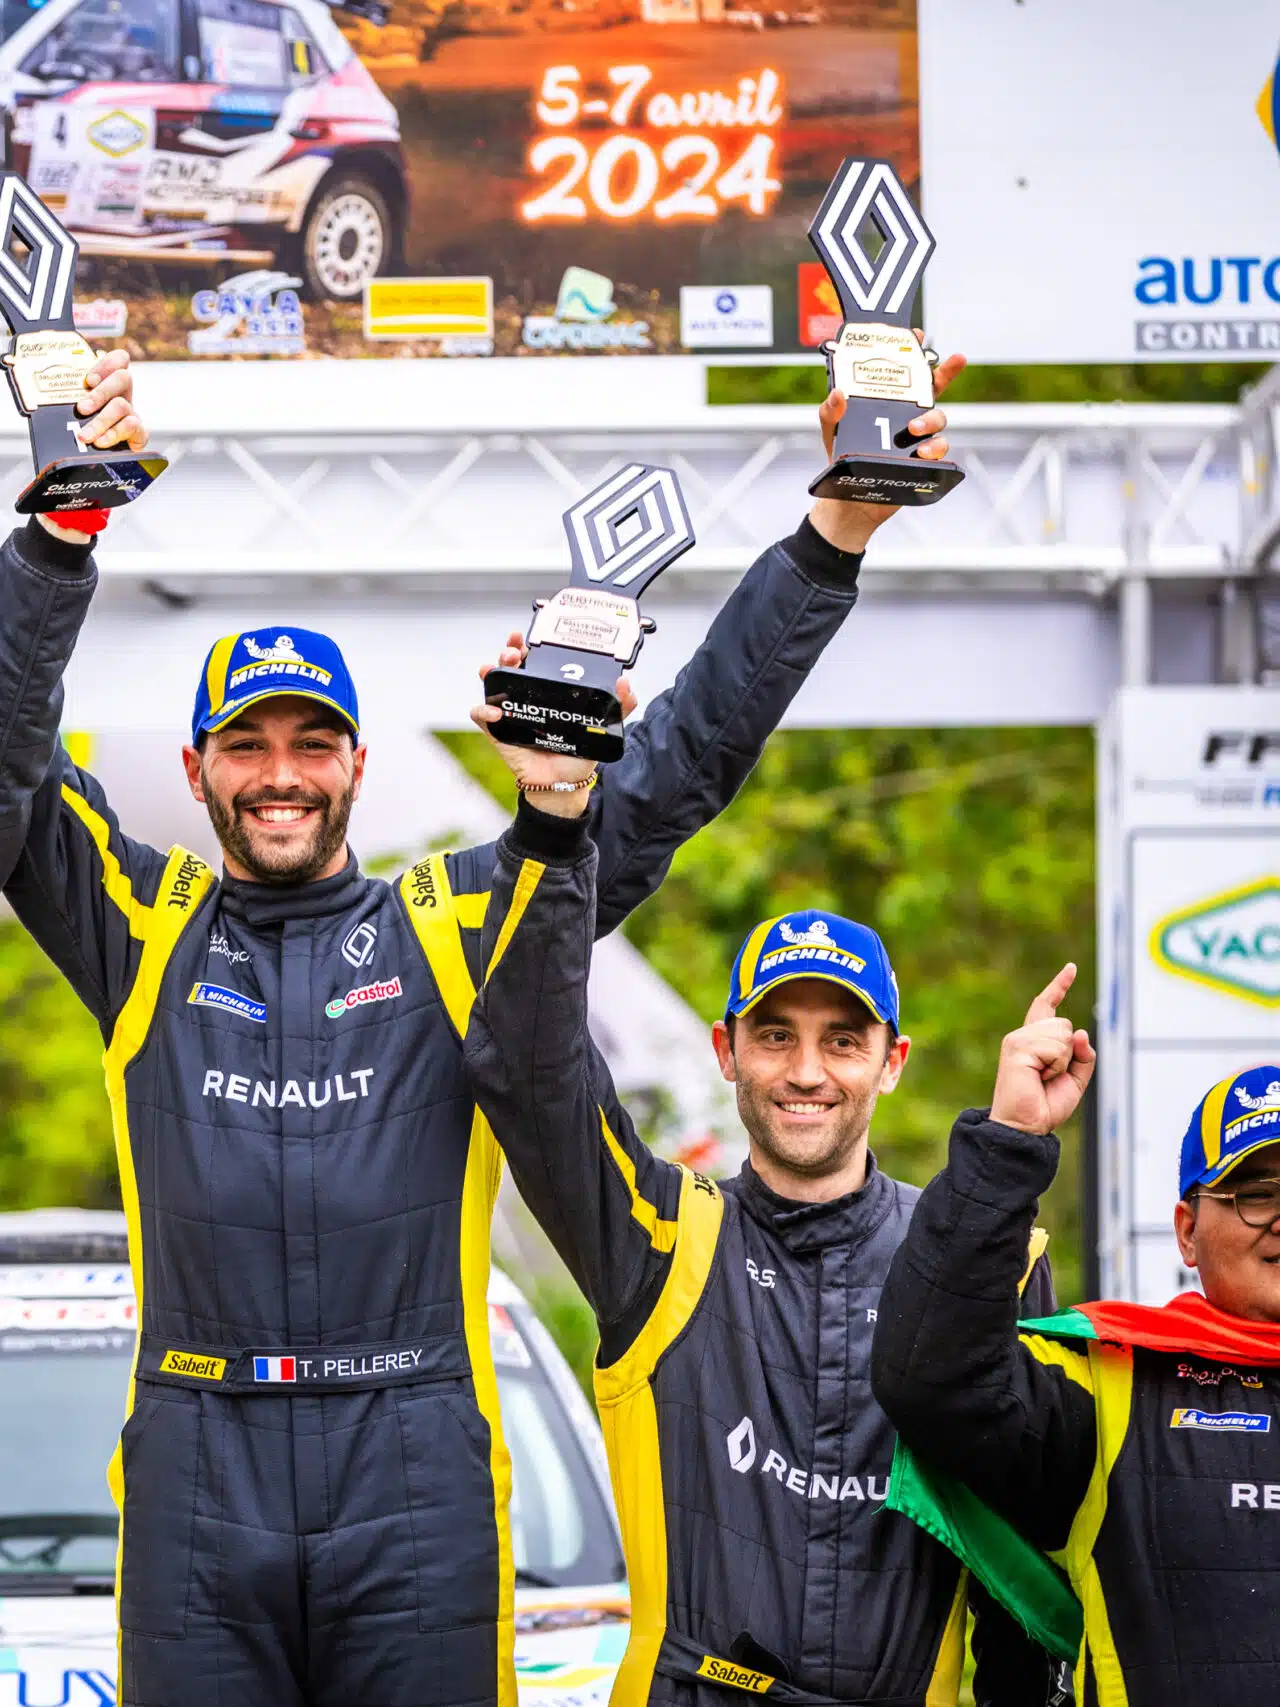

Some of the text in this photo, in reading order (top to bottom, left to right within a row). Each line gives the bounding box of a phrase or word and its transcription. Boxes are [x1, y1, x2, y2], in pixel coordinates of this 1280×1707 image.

[538, 65, 782, 127] 5-7 avril
[523, 135, 782, 221] 2024
[66, 421, 88, 453] 1
[874, 416, 892, 451] 1
[47, 477, 142, 493] CLIOTROPHY
[838, 475, 940, 490] CLIOTROPHY
[229, 663, 333, 690] MICHELIN
[501, 700, 606, 727] CLIOTROPHY
[512, 711, 546, 724] FRANCE
[167, 854, 207, 911] Sabelt
[759, 948, 866, 975] MICHELIN
[206, 991, 265, 1017] MICHELIN
[346, 979, 400, 1007] Castrol
[202, 1067, 375, 1109] RENAULT
[167, 1353, 220, 1377] Sabelt
[299, 1349, 423, 1379] T. PELLEREY
[1199, 1417, 1261, 1426] MICHELIN
[761, 1449, 893, 1501] RENAU
[706, 1660, 768, 1691] Sabelt
